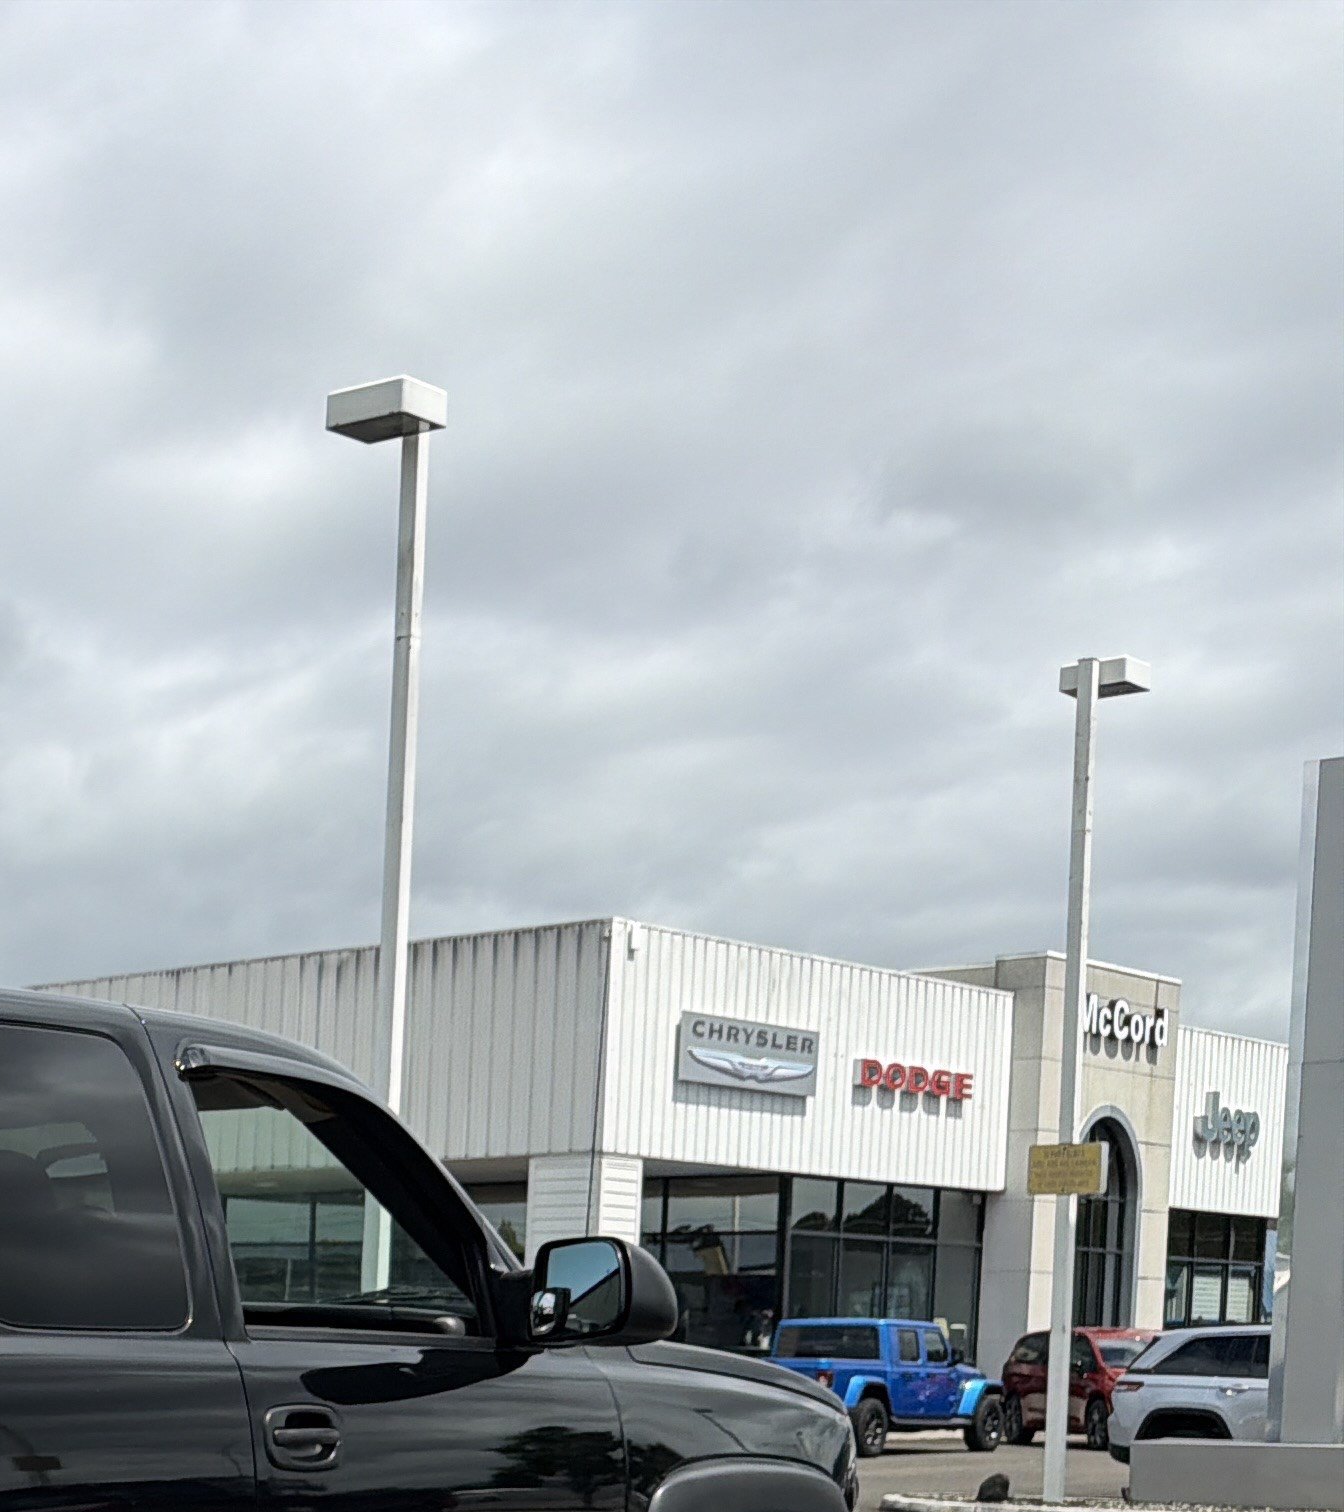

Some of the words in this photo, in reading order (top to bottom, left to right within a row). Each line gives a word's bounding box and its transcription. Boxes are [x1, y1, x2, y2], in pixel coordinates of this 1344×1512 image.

[691, 1019, 815, 1054] CHRYSLER
[1083, 993, 1169, 1047] McCord
[861, 1058, 974, 1100] DODGE
[1193, 1091, 1260, 1157] Jeep
